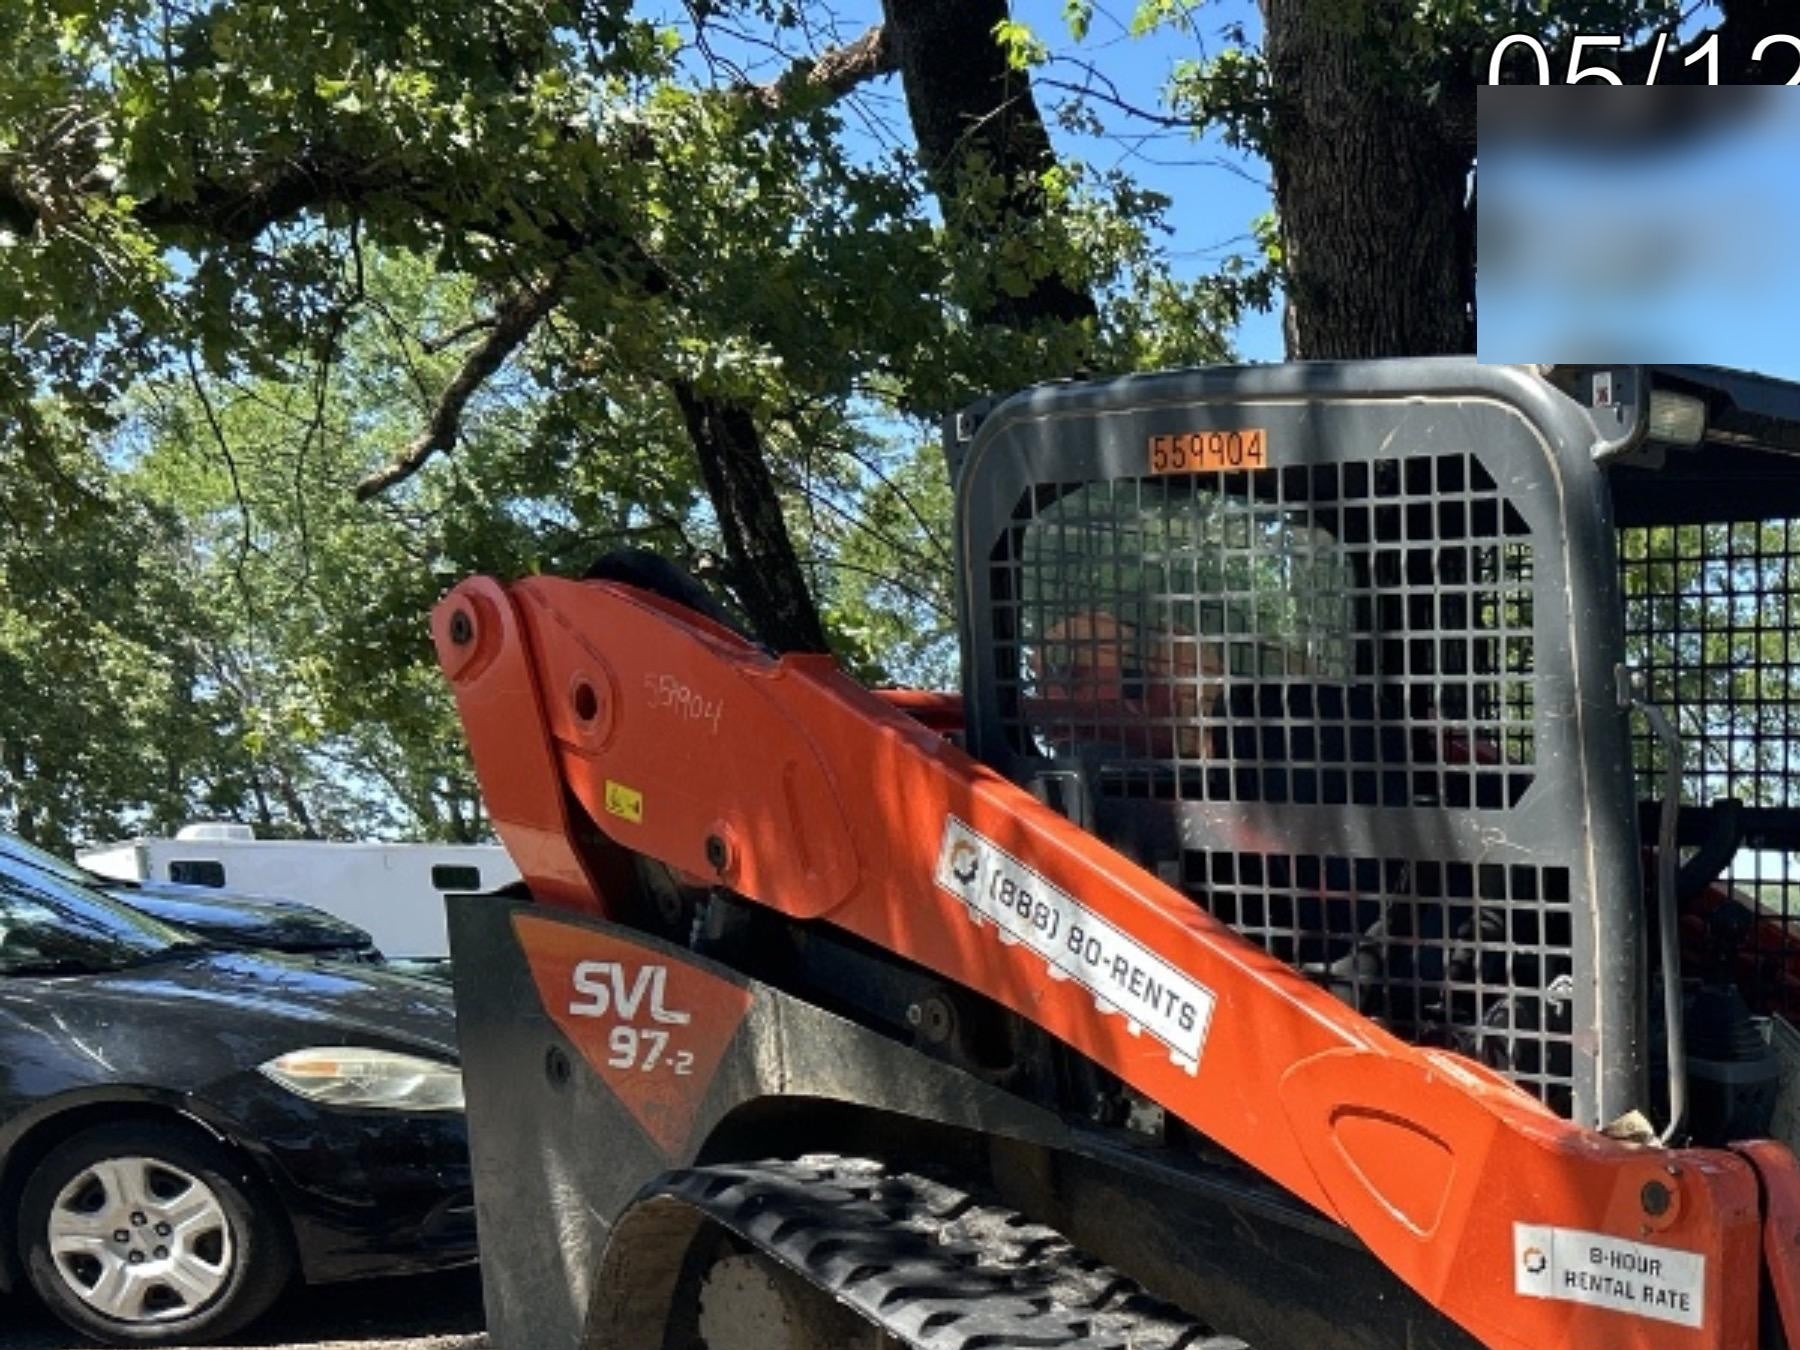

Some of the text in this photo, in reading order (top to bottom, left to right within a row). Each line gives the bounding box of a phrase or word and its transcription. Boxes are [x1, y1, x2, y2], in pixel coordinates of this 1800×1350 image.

[1153, 431, 1263, 472] 559904
[988, 869, 1061, 939] (888)
[568, 960, 692, 1025] SVL
[1588, 1247, 1662, 1277] 8-HOUR
[1564, 1270, 1691, 1312] RENTAL RATE
